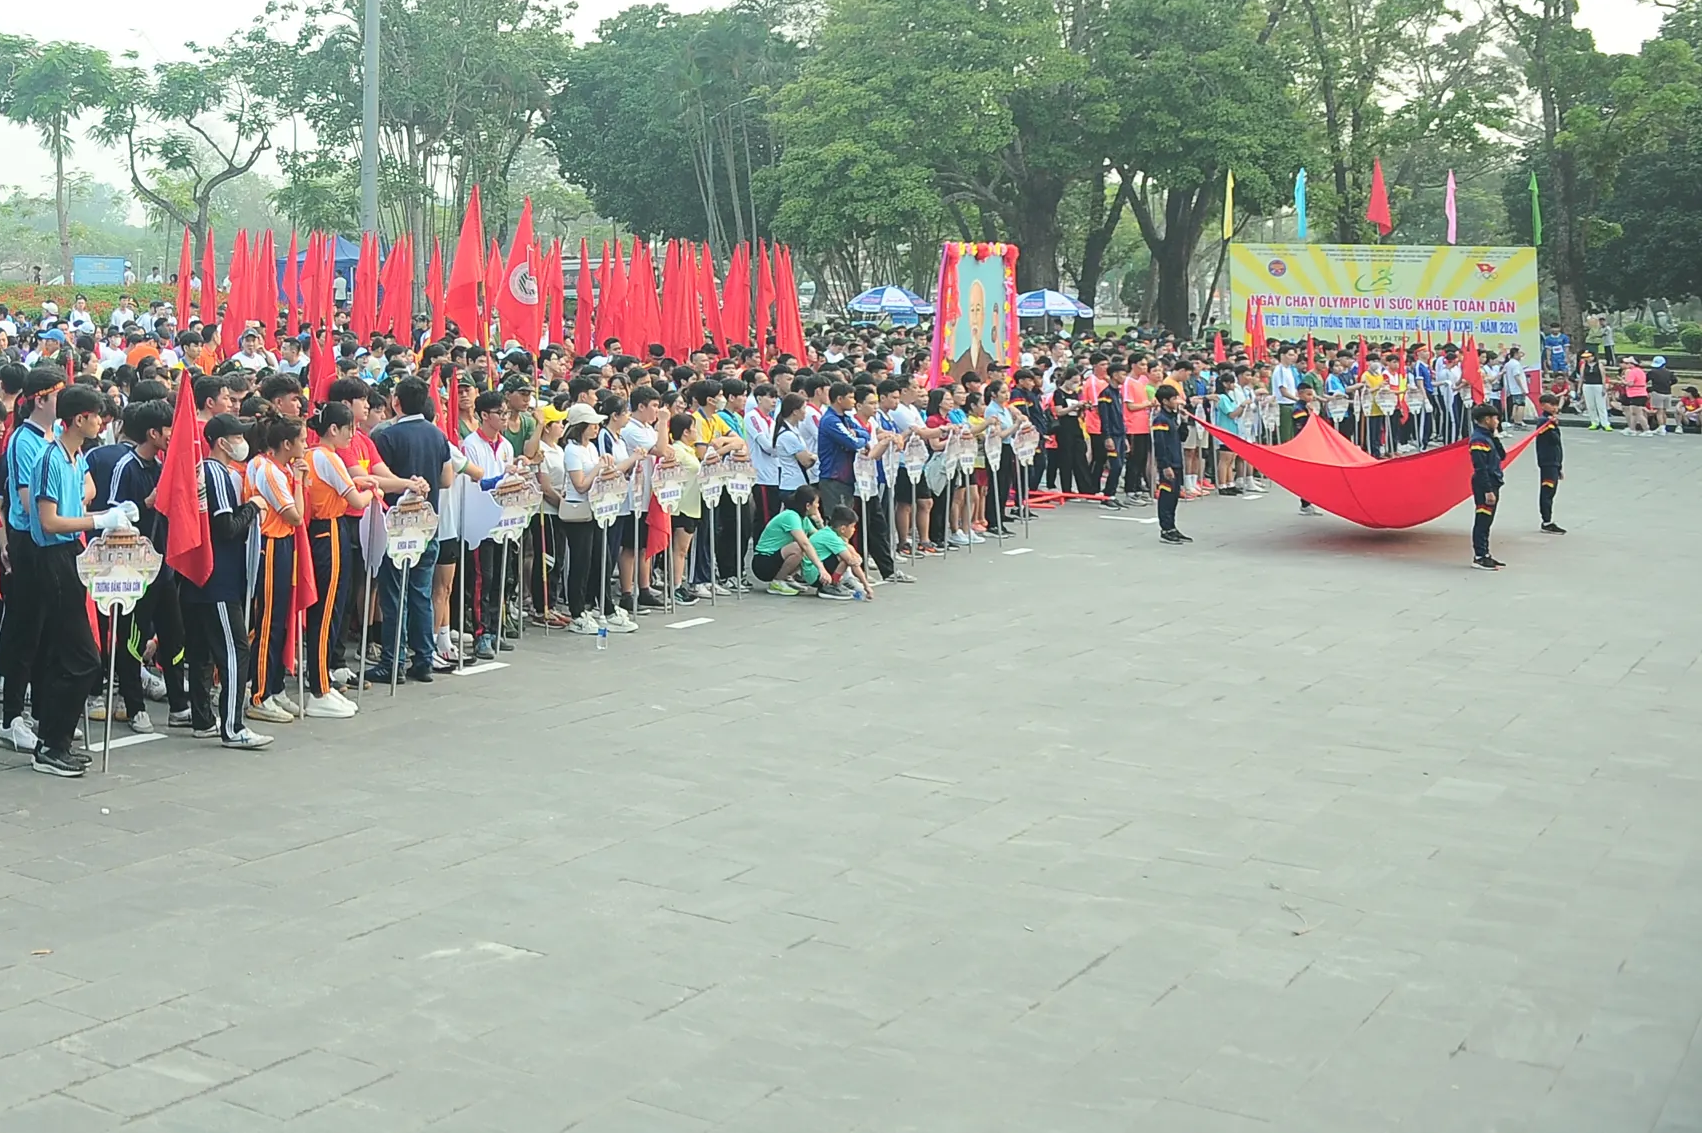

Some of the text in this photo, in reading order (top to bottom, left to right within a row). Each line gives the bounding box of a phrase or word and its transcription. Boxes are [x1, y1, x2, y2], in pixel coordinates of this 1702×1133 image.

[1251, 293, 1515, 313] NGÀY CHẠY OLYMPIC VÌ SỨC KHỎE TOÀN DÂN
[1500, 322, 1518, 334] 2024
